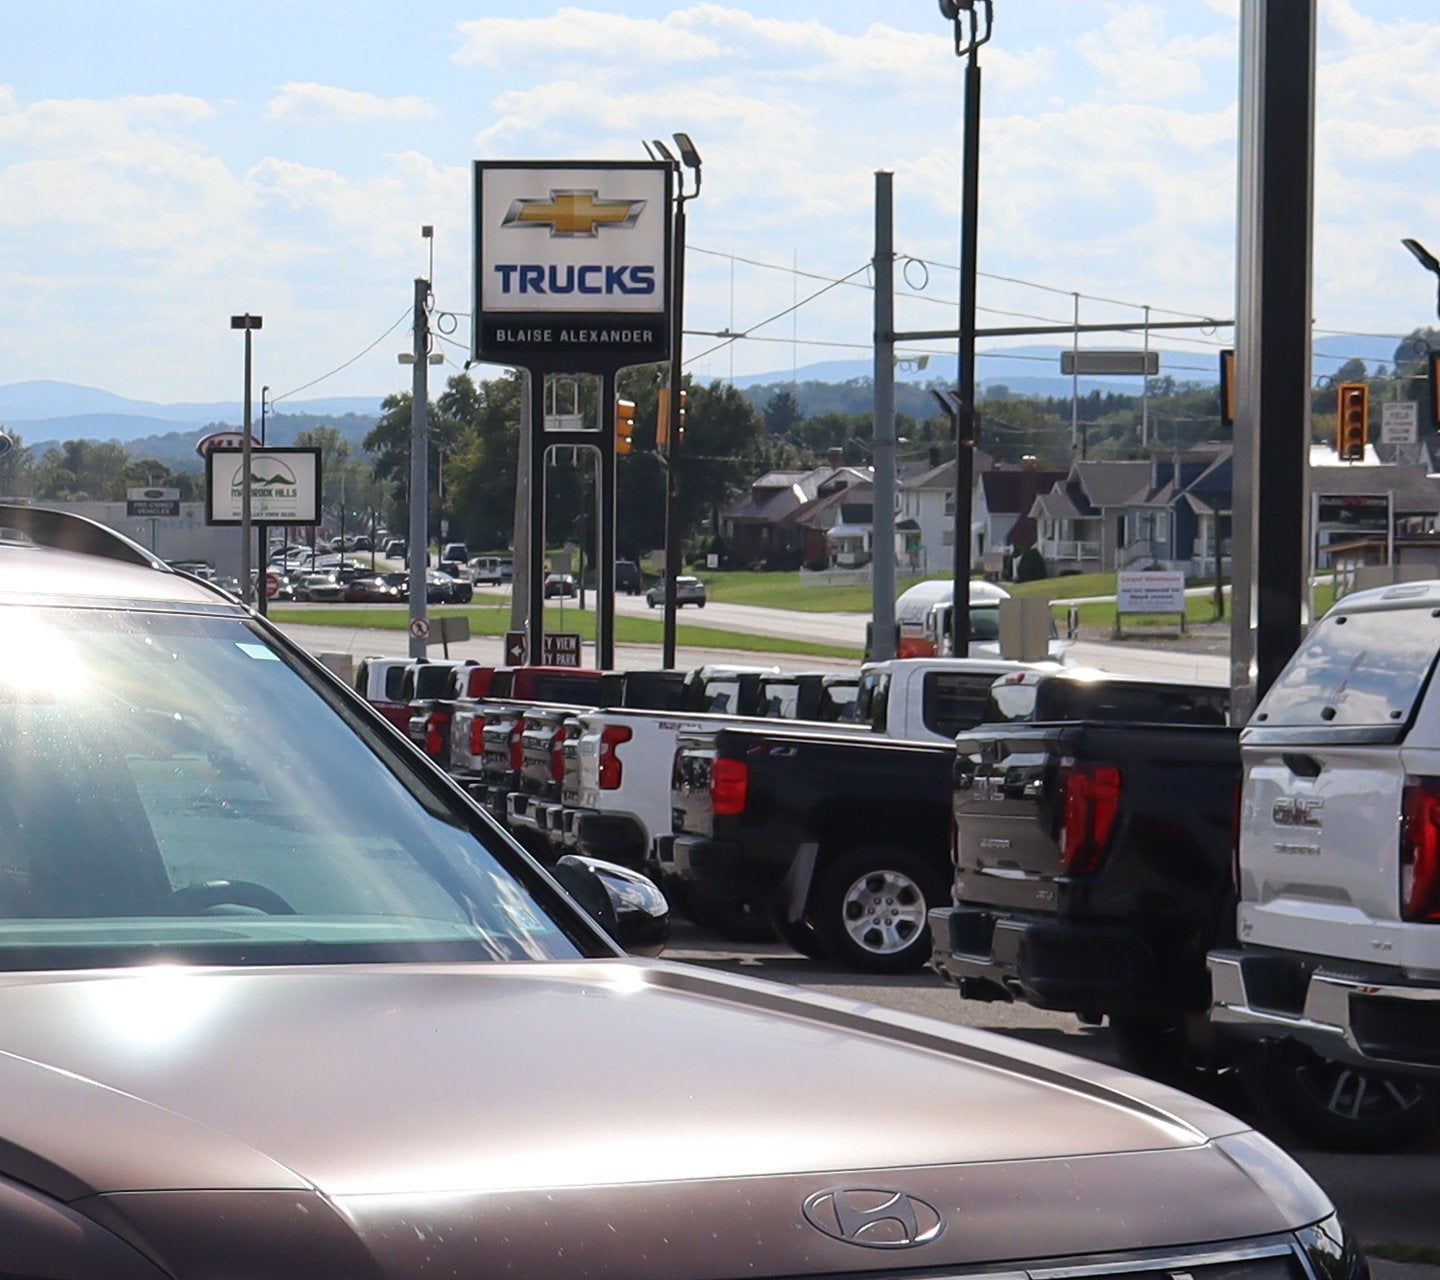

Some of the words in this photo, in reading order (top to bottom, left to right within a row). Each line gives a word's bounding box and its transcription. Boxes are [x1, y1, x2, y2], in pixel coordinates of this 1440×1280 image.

[494, 264, 656, 295] TRUCKS
[496, 329, 553, 343] BLAISE
[559, 329, 653, 343] ALEXANDER
[555, 636, 577, 650] VIEW
